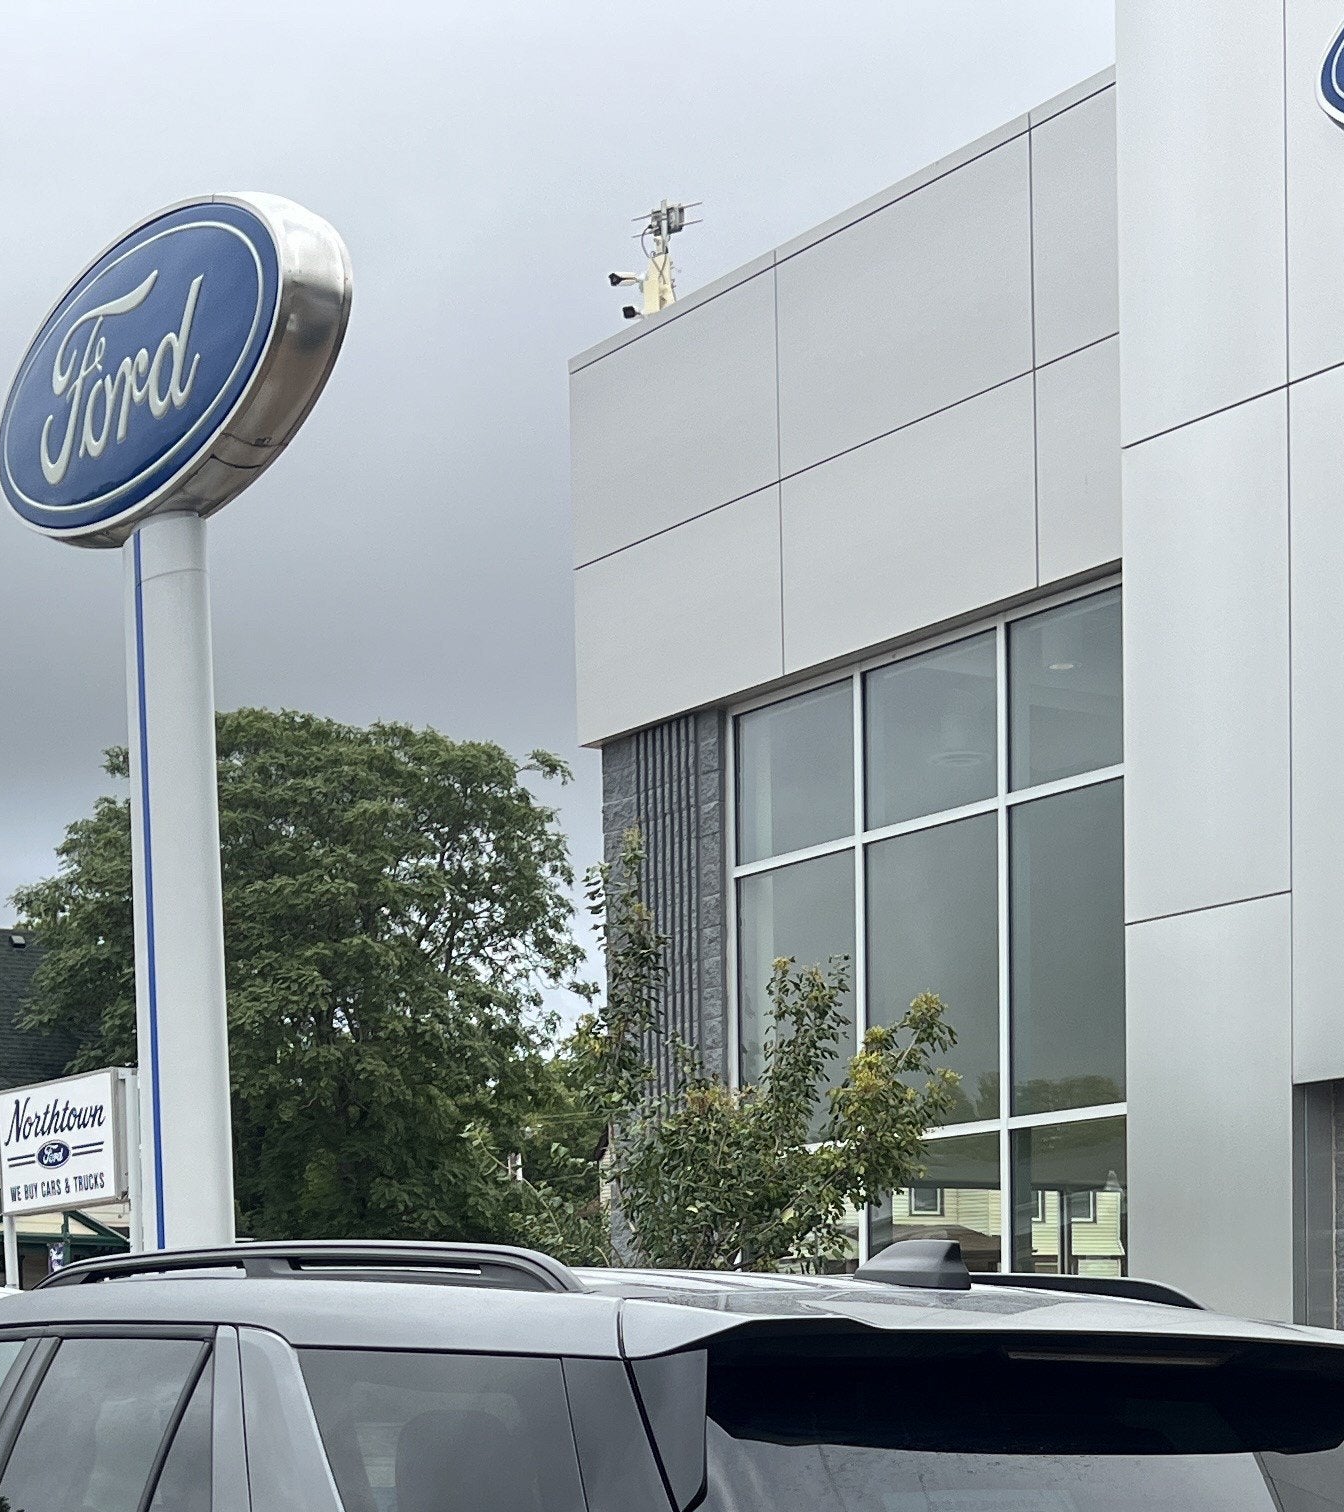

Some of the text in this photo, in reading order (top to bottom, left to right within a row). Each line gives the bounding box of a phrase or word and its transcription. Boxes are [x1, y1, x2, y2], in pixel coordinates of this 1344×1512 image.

[40, 270, 204, 485] Ford
[4, 1097, 107, 1147] Northtown
[42, 1144, 64, 1165] Ford
[10, 1172, 105, 1202] WE BUY CARS & TRUCKS
